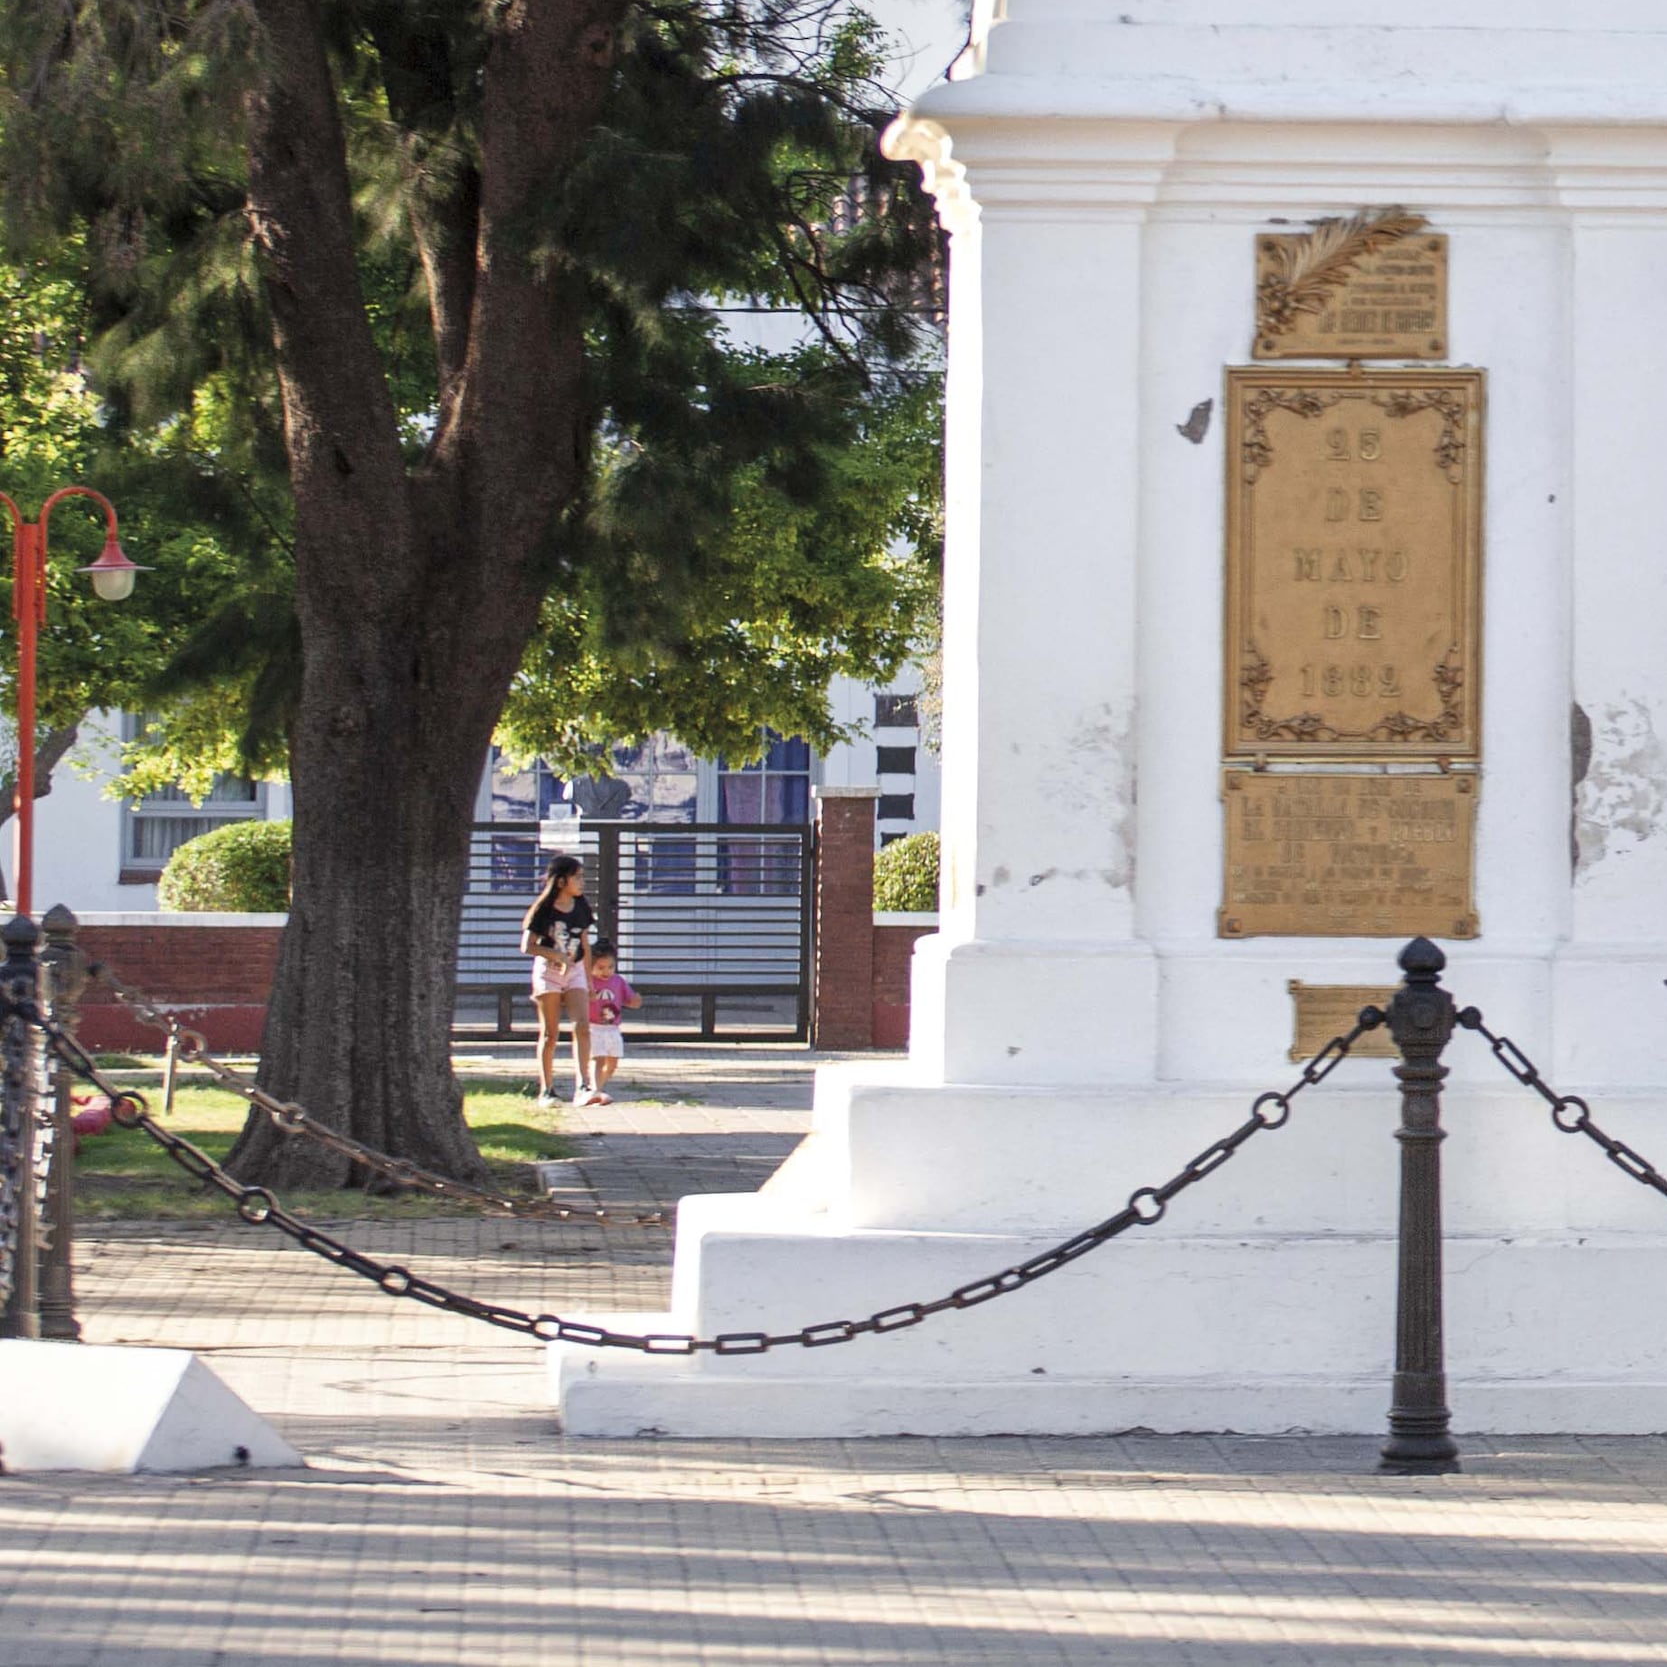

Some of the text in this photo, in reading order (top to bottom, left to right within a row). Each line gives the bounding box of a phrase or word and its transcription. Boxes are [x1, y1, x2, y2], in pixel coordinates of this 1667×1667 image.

[1325, 426, 1382, 462] 25
[1324, 486, 1383, 523] DE
[1292, 546, 1410, 583] MAYO
[1323, 604, 1383, 641] DE
